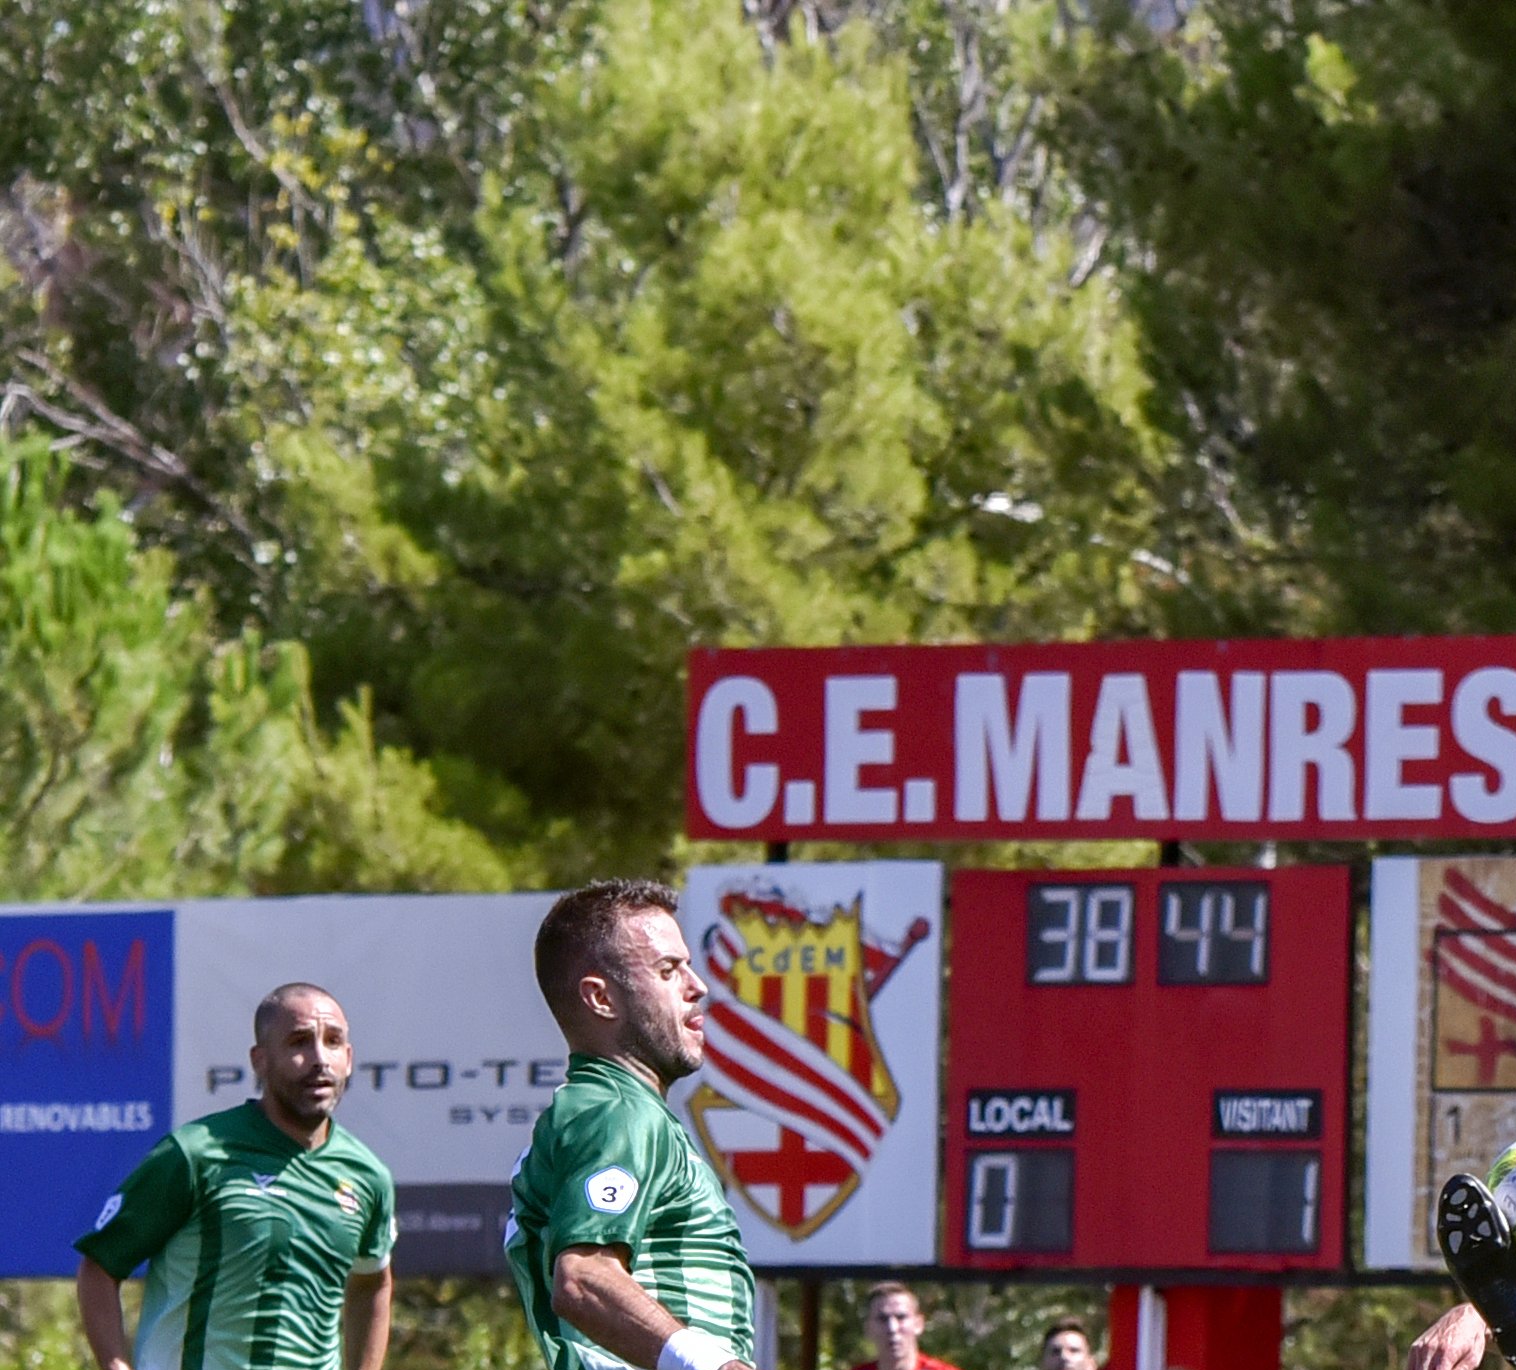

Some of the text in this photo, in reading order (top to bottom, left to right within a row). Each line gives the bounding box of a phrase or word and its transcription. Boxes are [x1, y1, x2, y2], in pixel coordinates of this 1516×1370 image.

[695, 674, 935, 829] C.E.
[1034, 887, 1269, 983] 38 44
[0, 938, 146, 1038] OM
[449, 1104, 541, 1124] SYS
[968, 1097, 1314, 1134] LOCAL VISITANT
